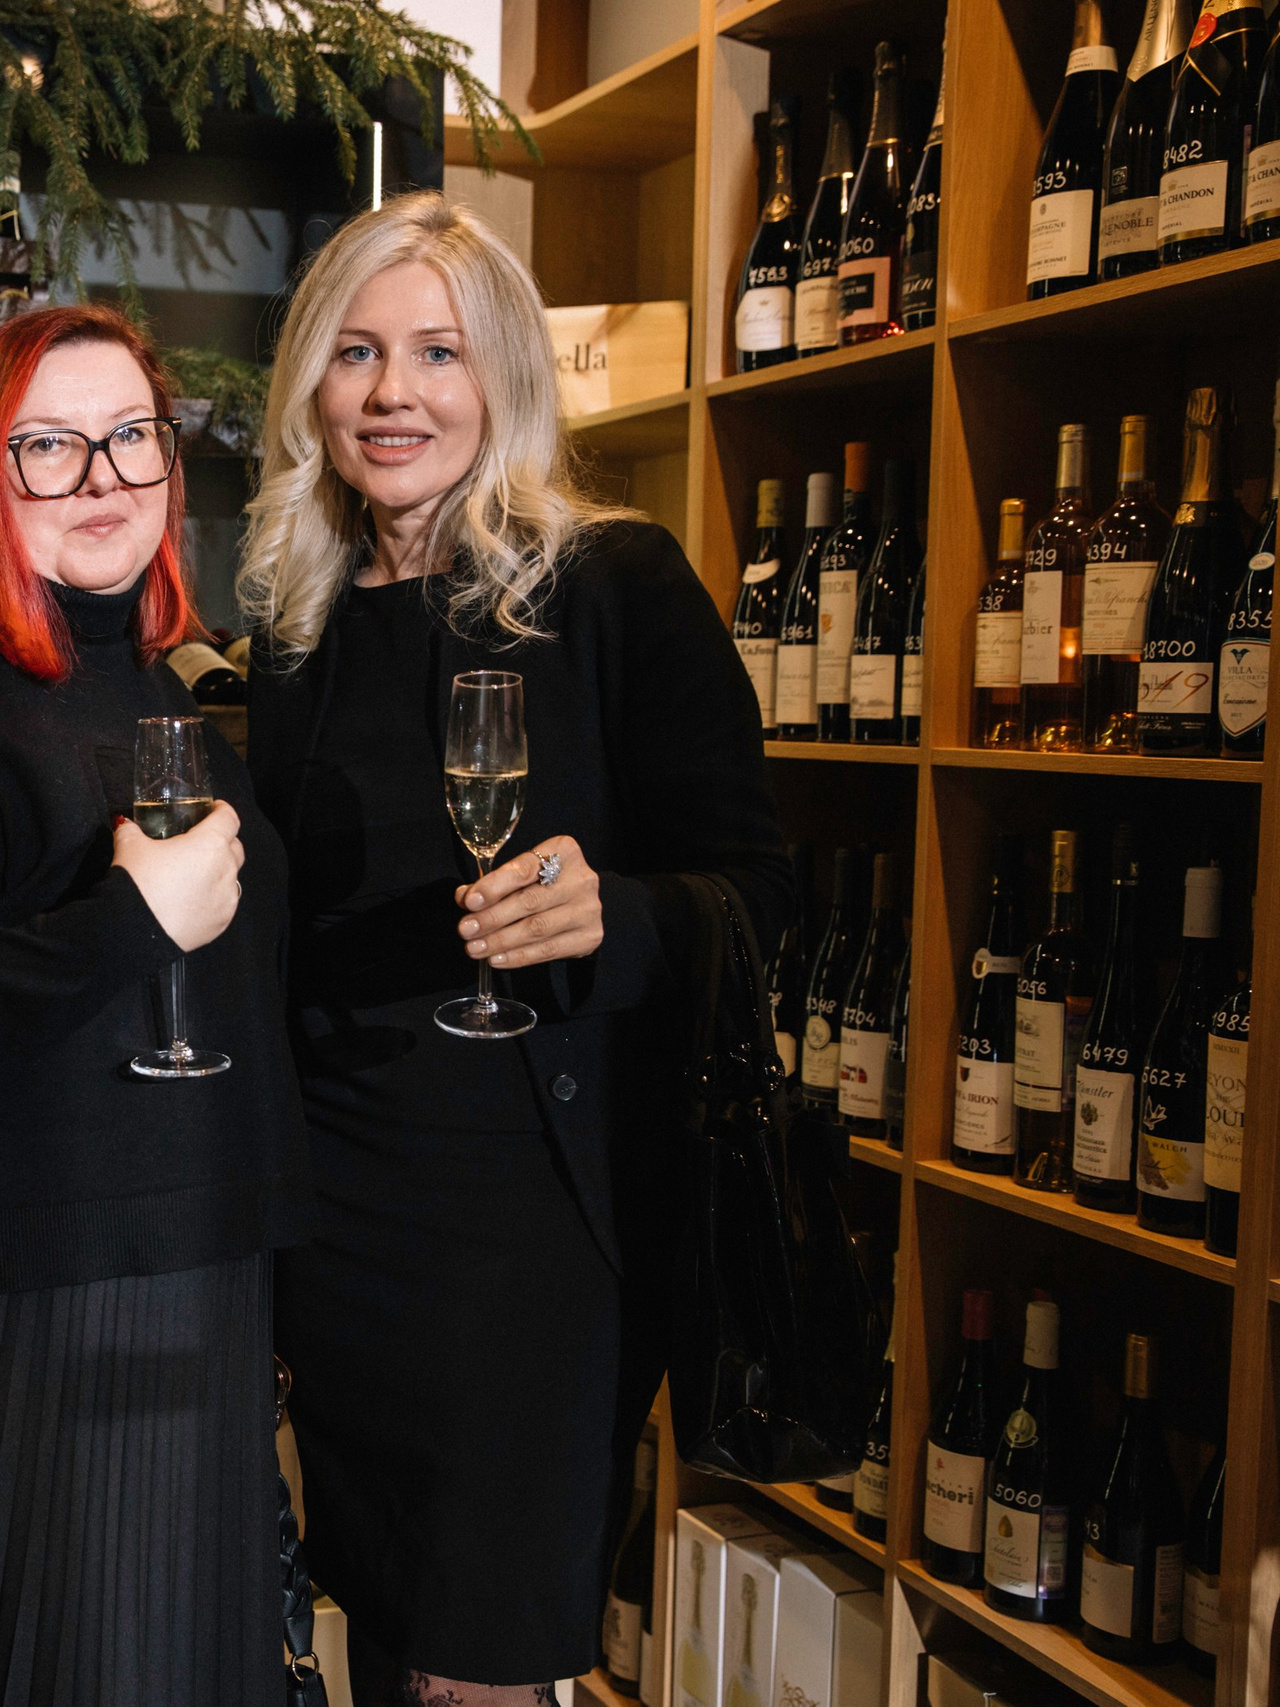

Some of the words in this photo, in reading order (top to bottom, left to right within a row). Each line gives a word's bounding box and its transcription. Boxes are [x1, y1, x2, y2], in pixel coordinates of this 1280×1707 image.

[1163, 139, 1204, 170] 8482
[1167, 187, 1215, 205] CHANDON
[1143, 639, 1197, 661] 18700
[1227, 666, 1252, 674] VILLA
[1082, 1040, 1129, 1066] 6479
[994, 1483, 1042, 1509] 5060
